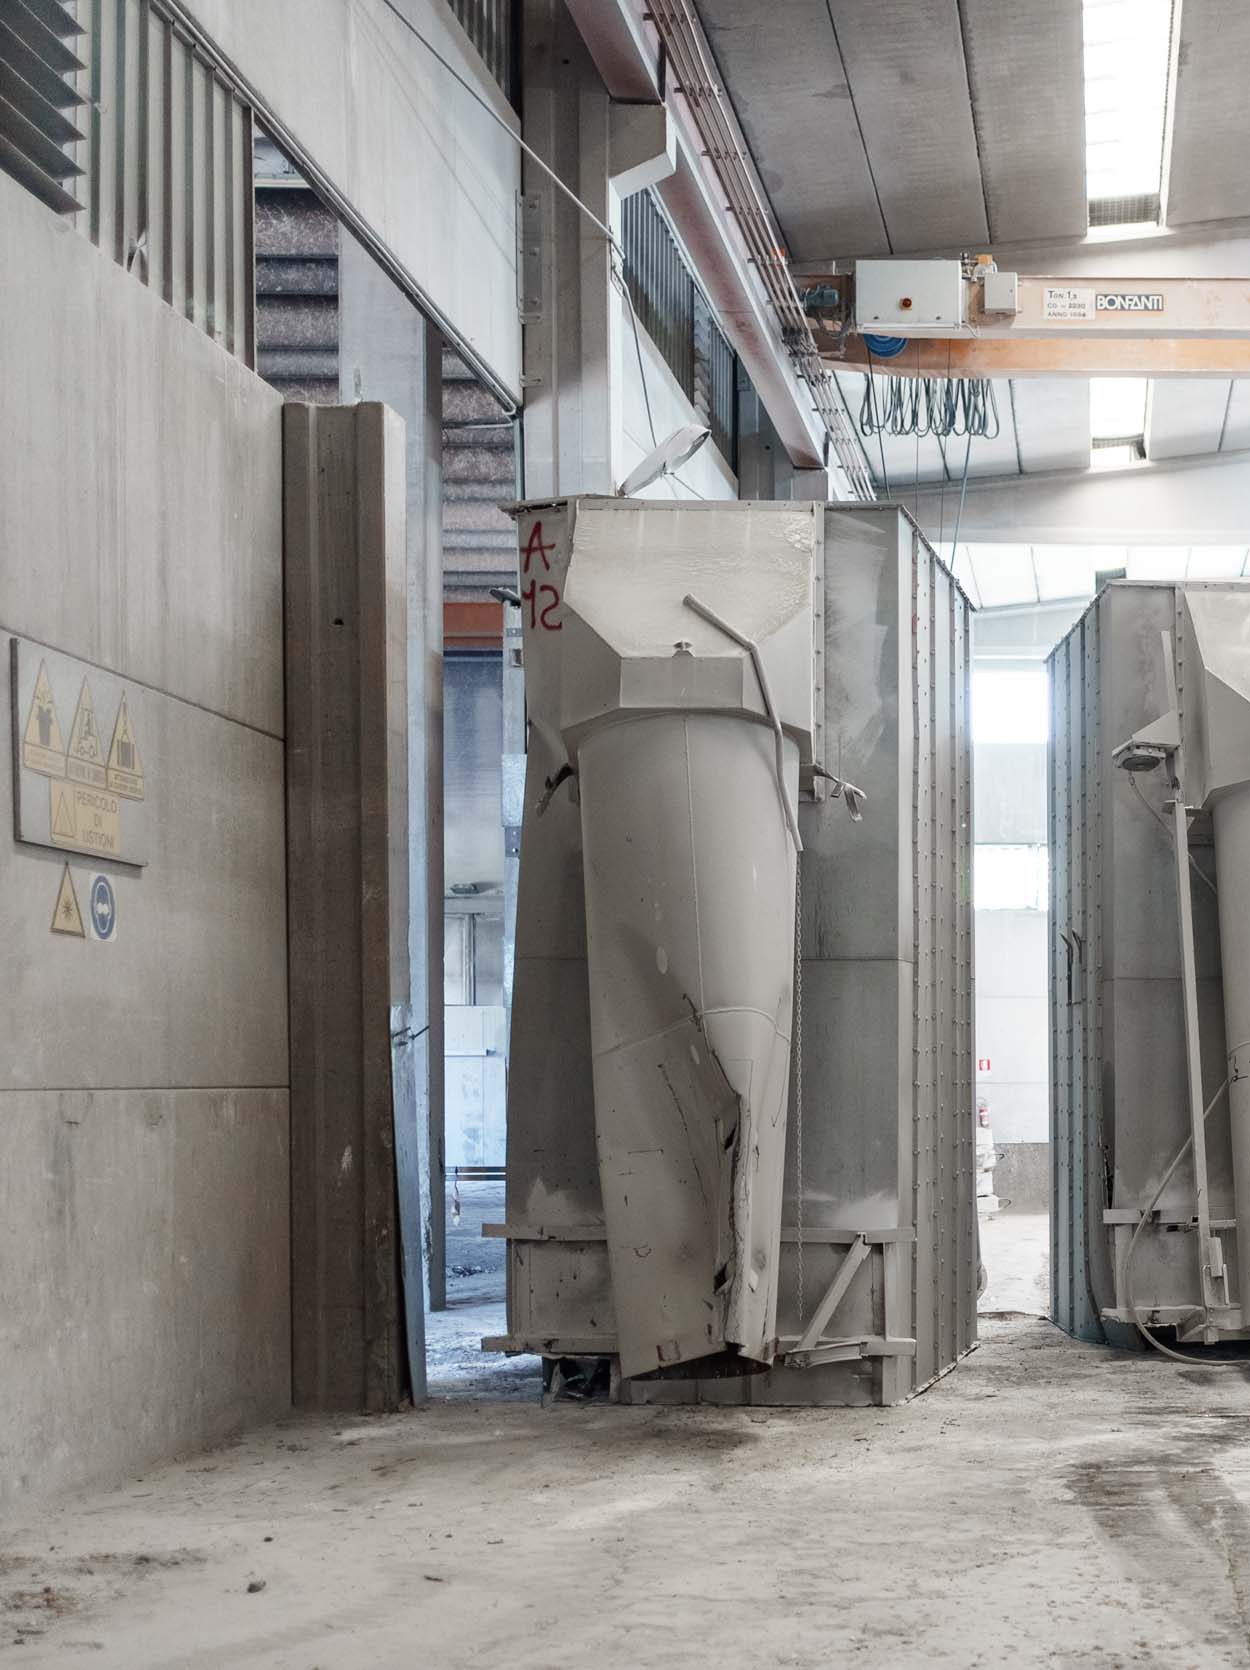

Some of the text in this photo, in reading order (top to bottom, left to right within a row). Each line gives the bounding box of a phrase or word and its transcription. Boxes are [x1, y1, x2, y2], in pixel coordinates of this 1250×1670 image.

[1096, 295, 1162, 310] BONFANTI
[520, 519, 557, 574] A
[521, 579, 563, 631] 12
[77, 790, 118, 814] PERICOLO
[94, 814, 103, 828] DI
